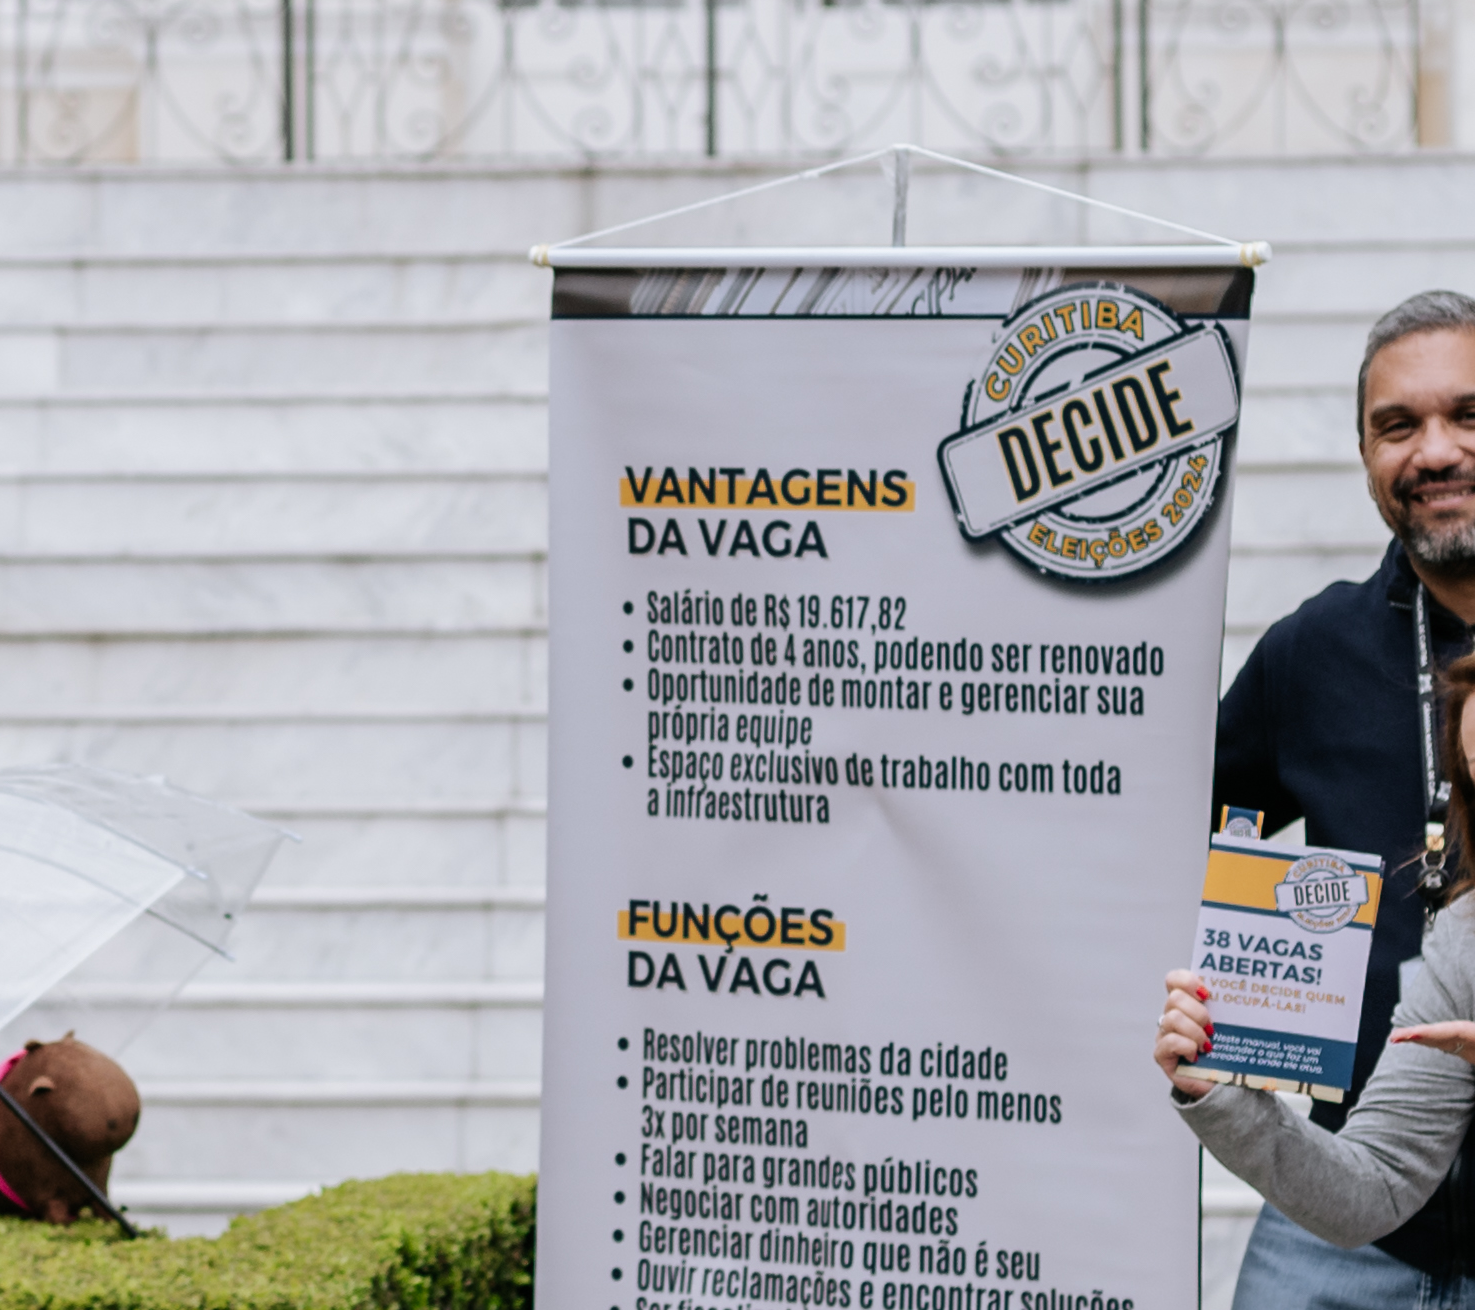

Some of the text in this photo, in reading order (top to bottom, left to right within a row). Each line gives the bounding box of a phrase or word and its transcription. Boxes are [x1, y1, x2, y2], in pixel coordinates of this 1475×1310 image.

[986, 301, 1144, 401] CURITIBA
[996, 359, 1193, 504] DECIDE
[626, 467, 907, 507] VANTAGENS
[1027, 453, 1208, 568] ELEIÇÕES 2024
[628, 517, 829, 559] DA VAGA
[647, 588, 906, 636] Salário de R$ 19.617,82
[647, 629, 1164, 677] Contrato de 4 anos, podendo ser renovado
[647, 667, 1144, 716] Oportunidade de montar e gerenciar sua
[649, 704, 812, 750] própria equipe
[648, 749, 1121, 796] Espaço exclusivo de trabalho com toda
[647, 783, 830, 824] a infraestrutura
[1293, 880, 1351, 906] DECIDE
[629, 894, 833, 954] FUNÇÕES
[1203, 928, 1324, 962] 38 VAGAS
[627, 947, 826, 1000] DA VAGA
[1200, 952, 1323, 986] ABERTAS!
[1210, 977, 1247, 991] VOCÊ
[1252, 982, 1301, 999] DECIDE
[1306, 991, 1346, 1005] QUEM
[643, 1027, 1008, 1082] Resolver problemas da cidade
[642, 1066, 1062, 1125] Participar de reuniões pelo menos
[641, 1104, 808, 1149] 3x por semana
[641, 1144, 978, 1199] Falar para grandes públicos
[640, 1181, 959, 1236] Negociar com autoridades
[639, 1220, 1040, 1281] Gerenciar dinheiro que não é seu
[637, 1258, 697, 1294] Ouvir
[859, 1280, 874, 1310] e
